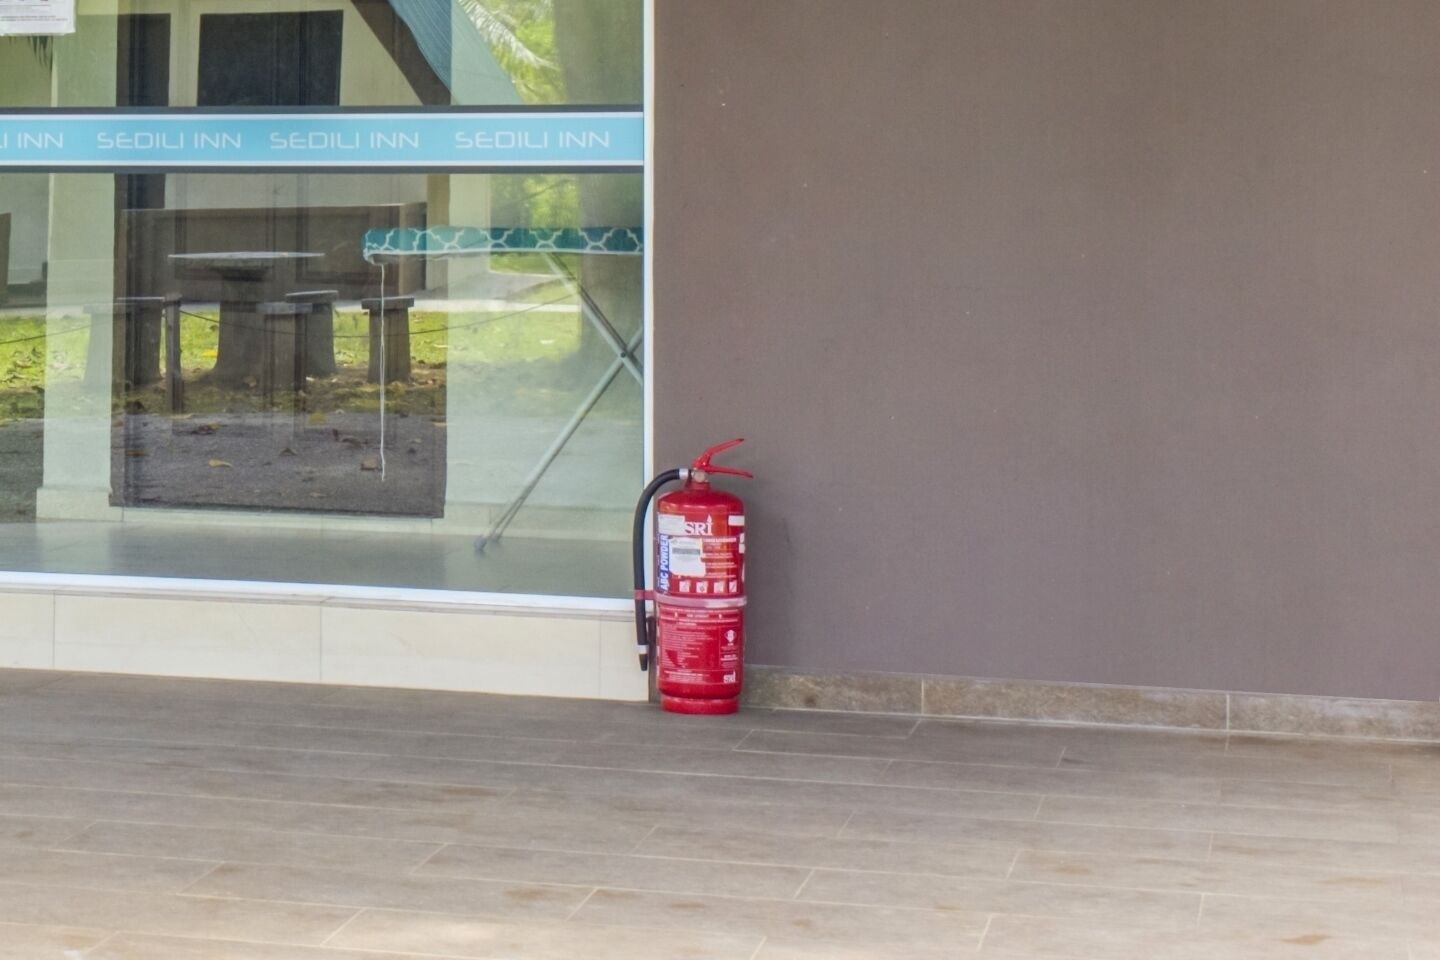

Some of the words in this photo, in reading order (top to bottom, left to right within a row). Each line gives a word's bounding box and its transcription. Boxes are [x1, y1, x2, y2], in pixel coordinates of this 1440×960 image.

[17, 131, 64, 150] INN
[97, 132, 184, 150] SEDILI
[194, 132, 241, 150] INN
[270, 131, 360, 149] SEDILI
[370, 131, 420, 149] INN
[455, 131, 549, 149] SEDILI
[559, 131, 611, 149] INN
[659, 534, 670, 571] POWDER
